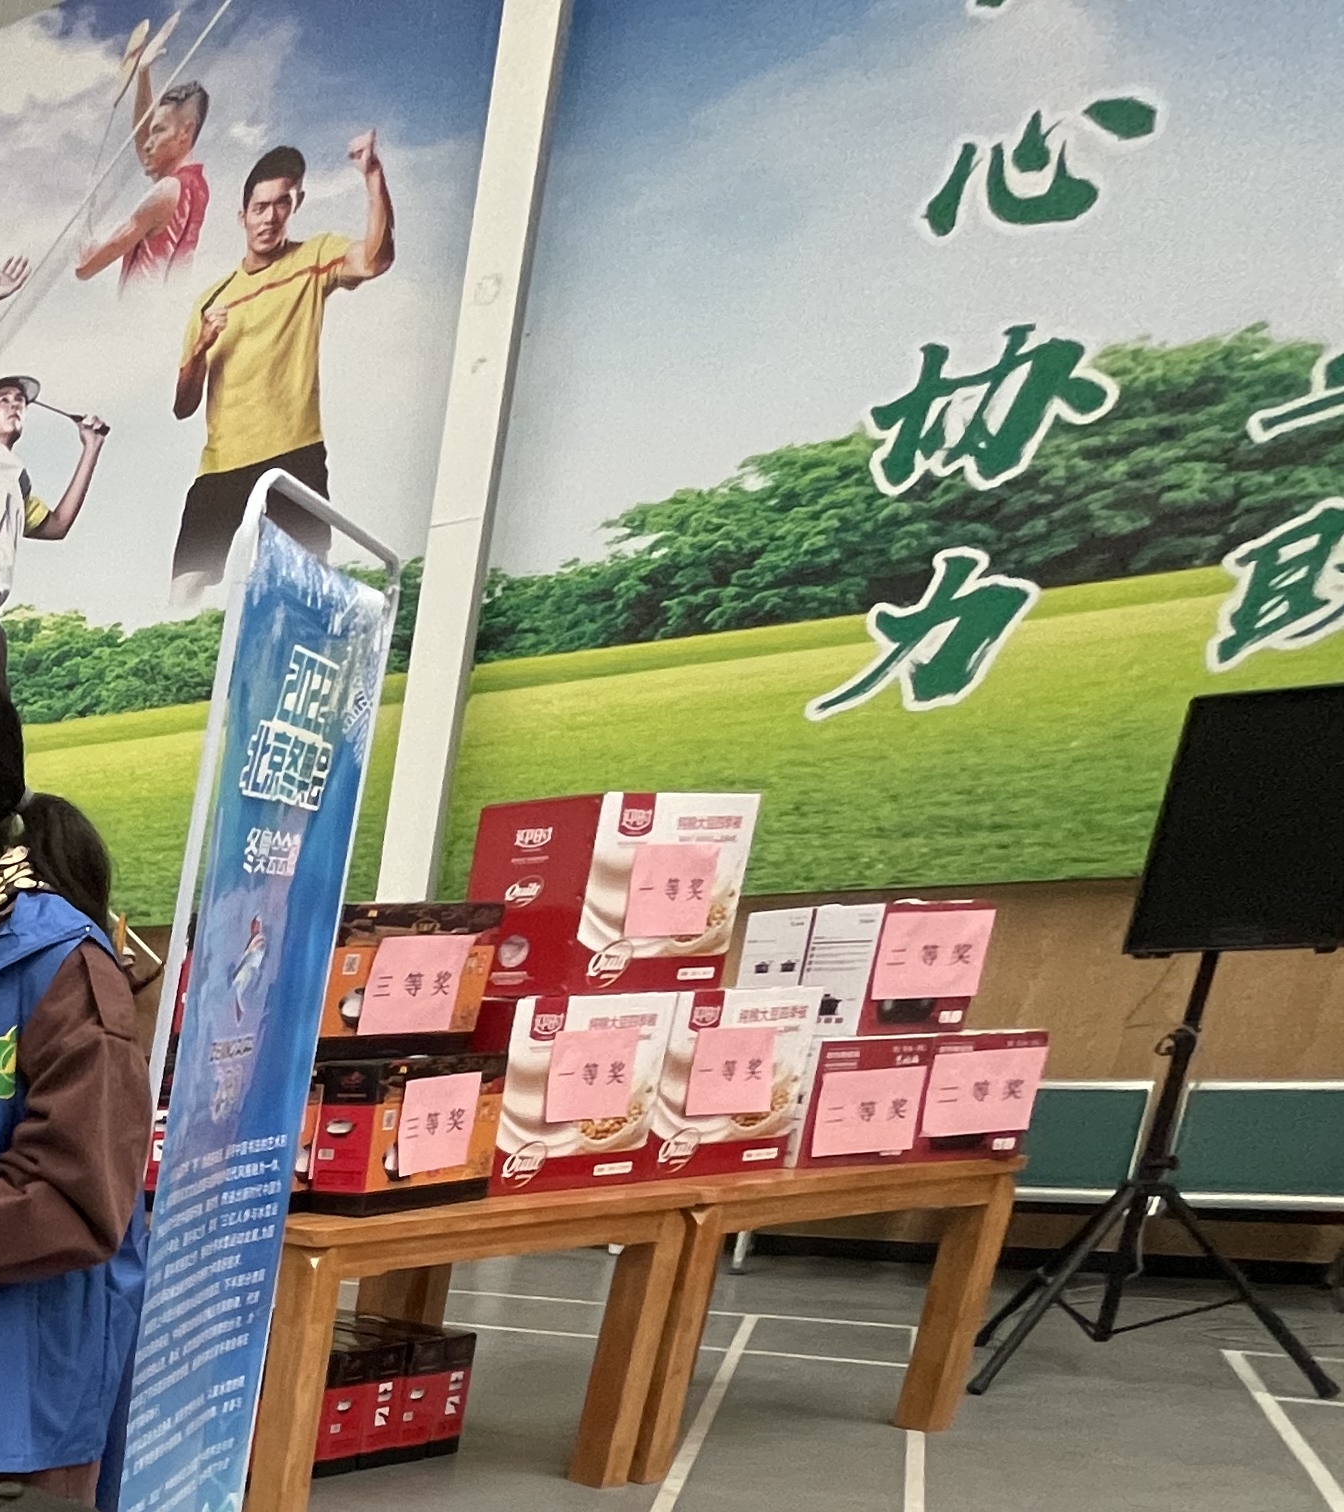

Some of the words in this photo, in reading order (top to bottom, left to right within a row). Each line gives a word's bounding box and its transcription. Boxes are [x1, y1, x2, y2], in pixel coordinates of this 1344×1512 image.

[809, 0, 1158, 714] 心协力
[639, 878, 704, 901] 一等奖
[886, 943, 973, 967] 二等奖
[372, 971, 452, 997] 三等奖
[558, 1060, 626, 1086] 一等奖
[698, 1057, 763, 1082] 一等奖
[936, 1078, 1025, 1103] 二等奖
[404, 1107, 466, 1139] 三等奖
[824, 1097, 909, 1123] 二等奖
